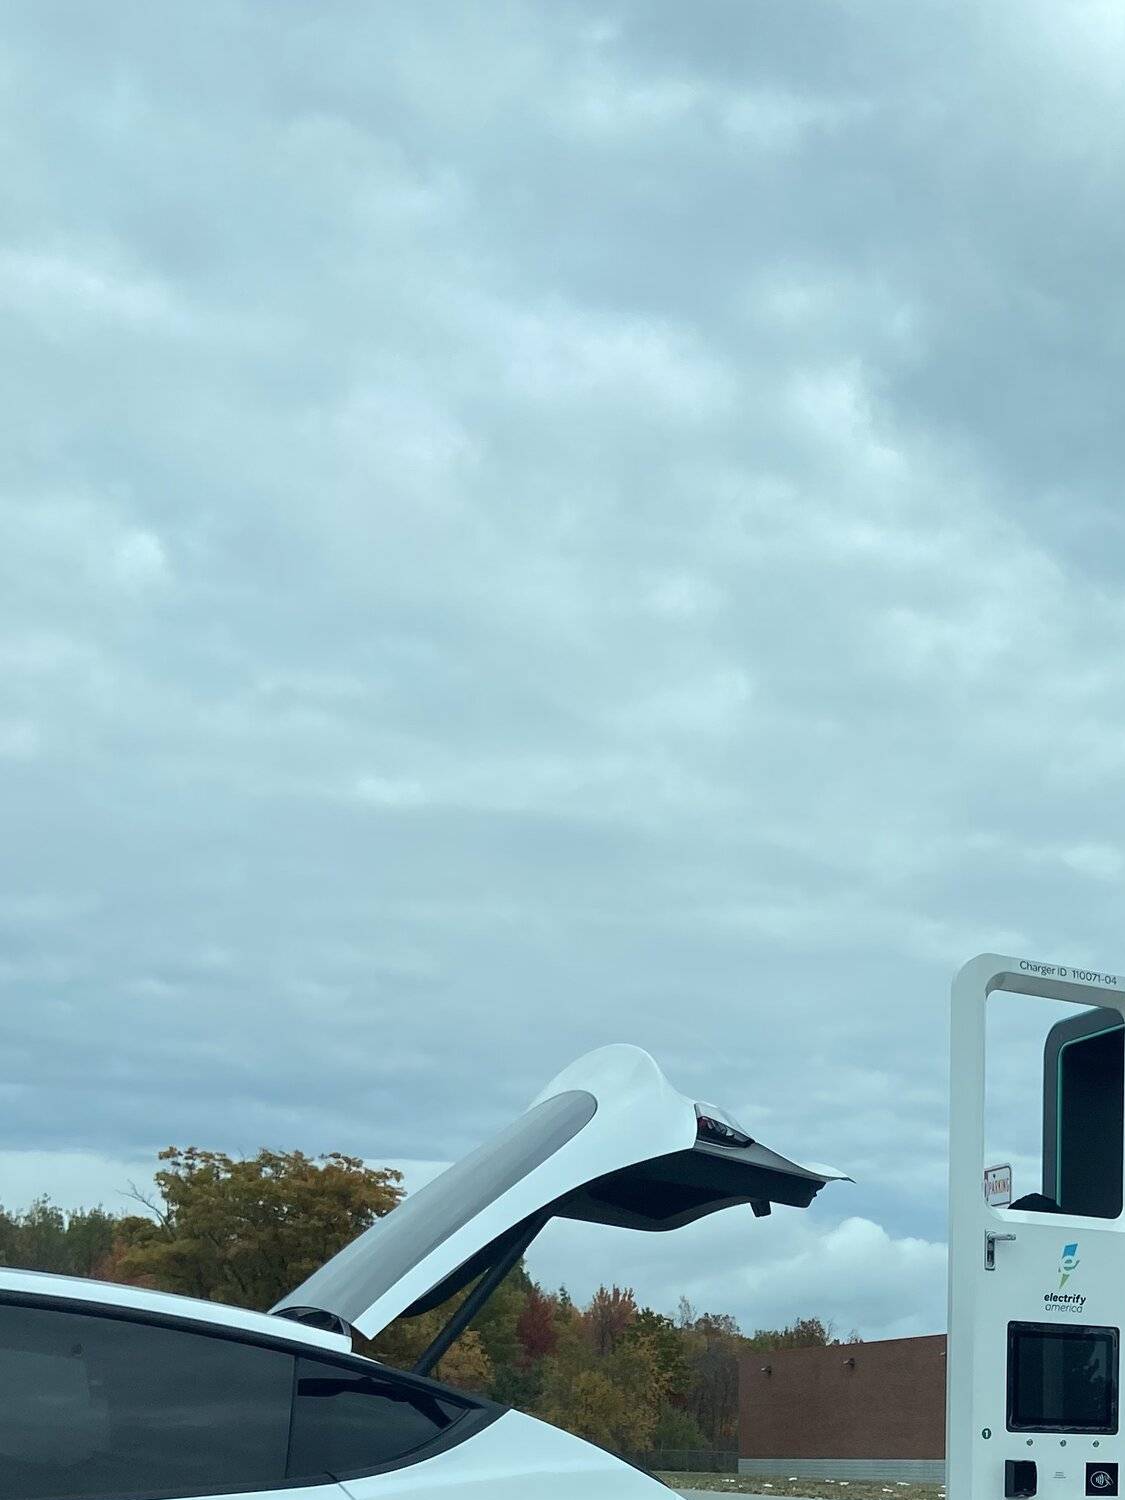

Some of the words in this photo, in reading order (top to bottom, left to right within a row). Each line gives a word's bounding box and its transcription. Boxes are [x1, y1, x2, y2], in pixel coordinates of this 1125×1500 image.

[1019, 960, 1056, 976] Charger
[1057, 967, 1067, 977] ID
[1072, 969, 1117, 985] 110071-04
[1044, 1292, 1087, 1306] electrify
[1045, 1303, 1083, 1313] america
